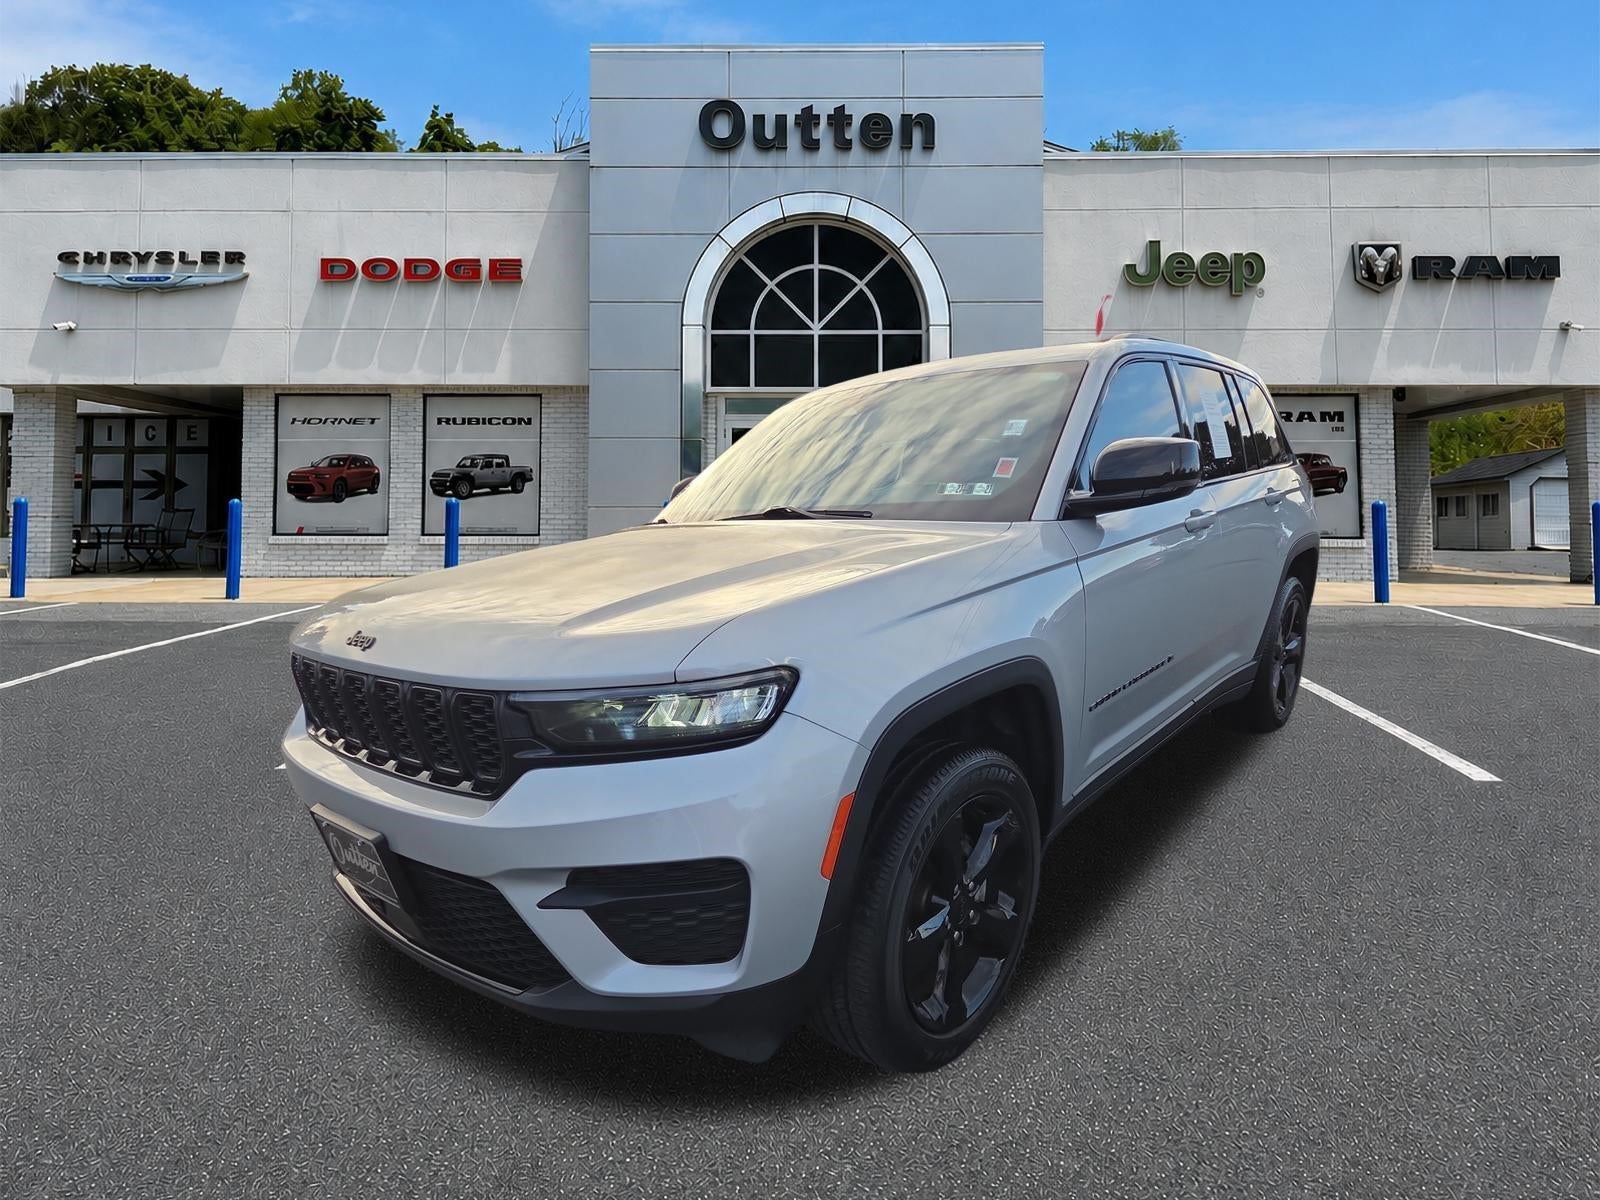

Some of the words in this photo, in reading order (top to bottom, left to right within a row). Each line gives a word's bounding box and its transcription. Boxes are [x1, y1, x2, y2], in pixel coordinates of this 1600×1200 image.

[698, 99, 936, 150] Outten
[57, 250, 247, 265] CHRYSLER
[1123, 239, 1266, 296] Jeep
[1411, 255, 1561, 280] RAM
[319, 257, 523, 282] DODGE
[290, 416, 382, 426] HORNET
[436, 416, 533, 426] RUBICON
[1279, 410, 1345, 423] RAM
[346, 630, 377, 652] Jeep
